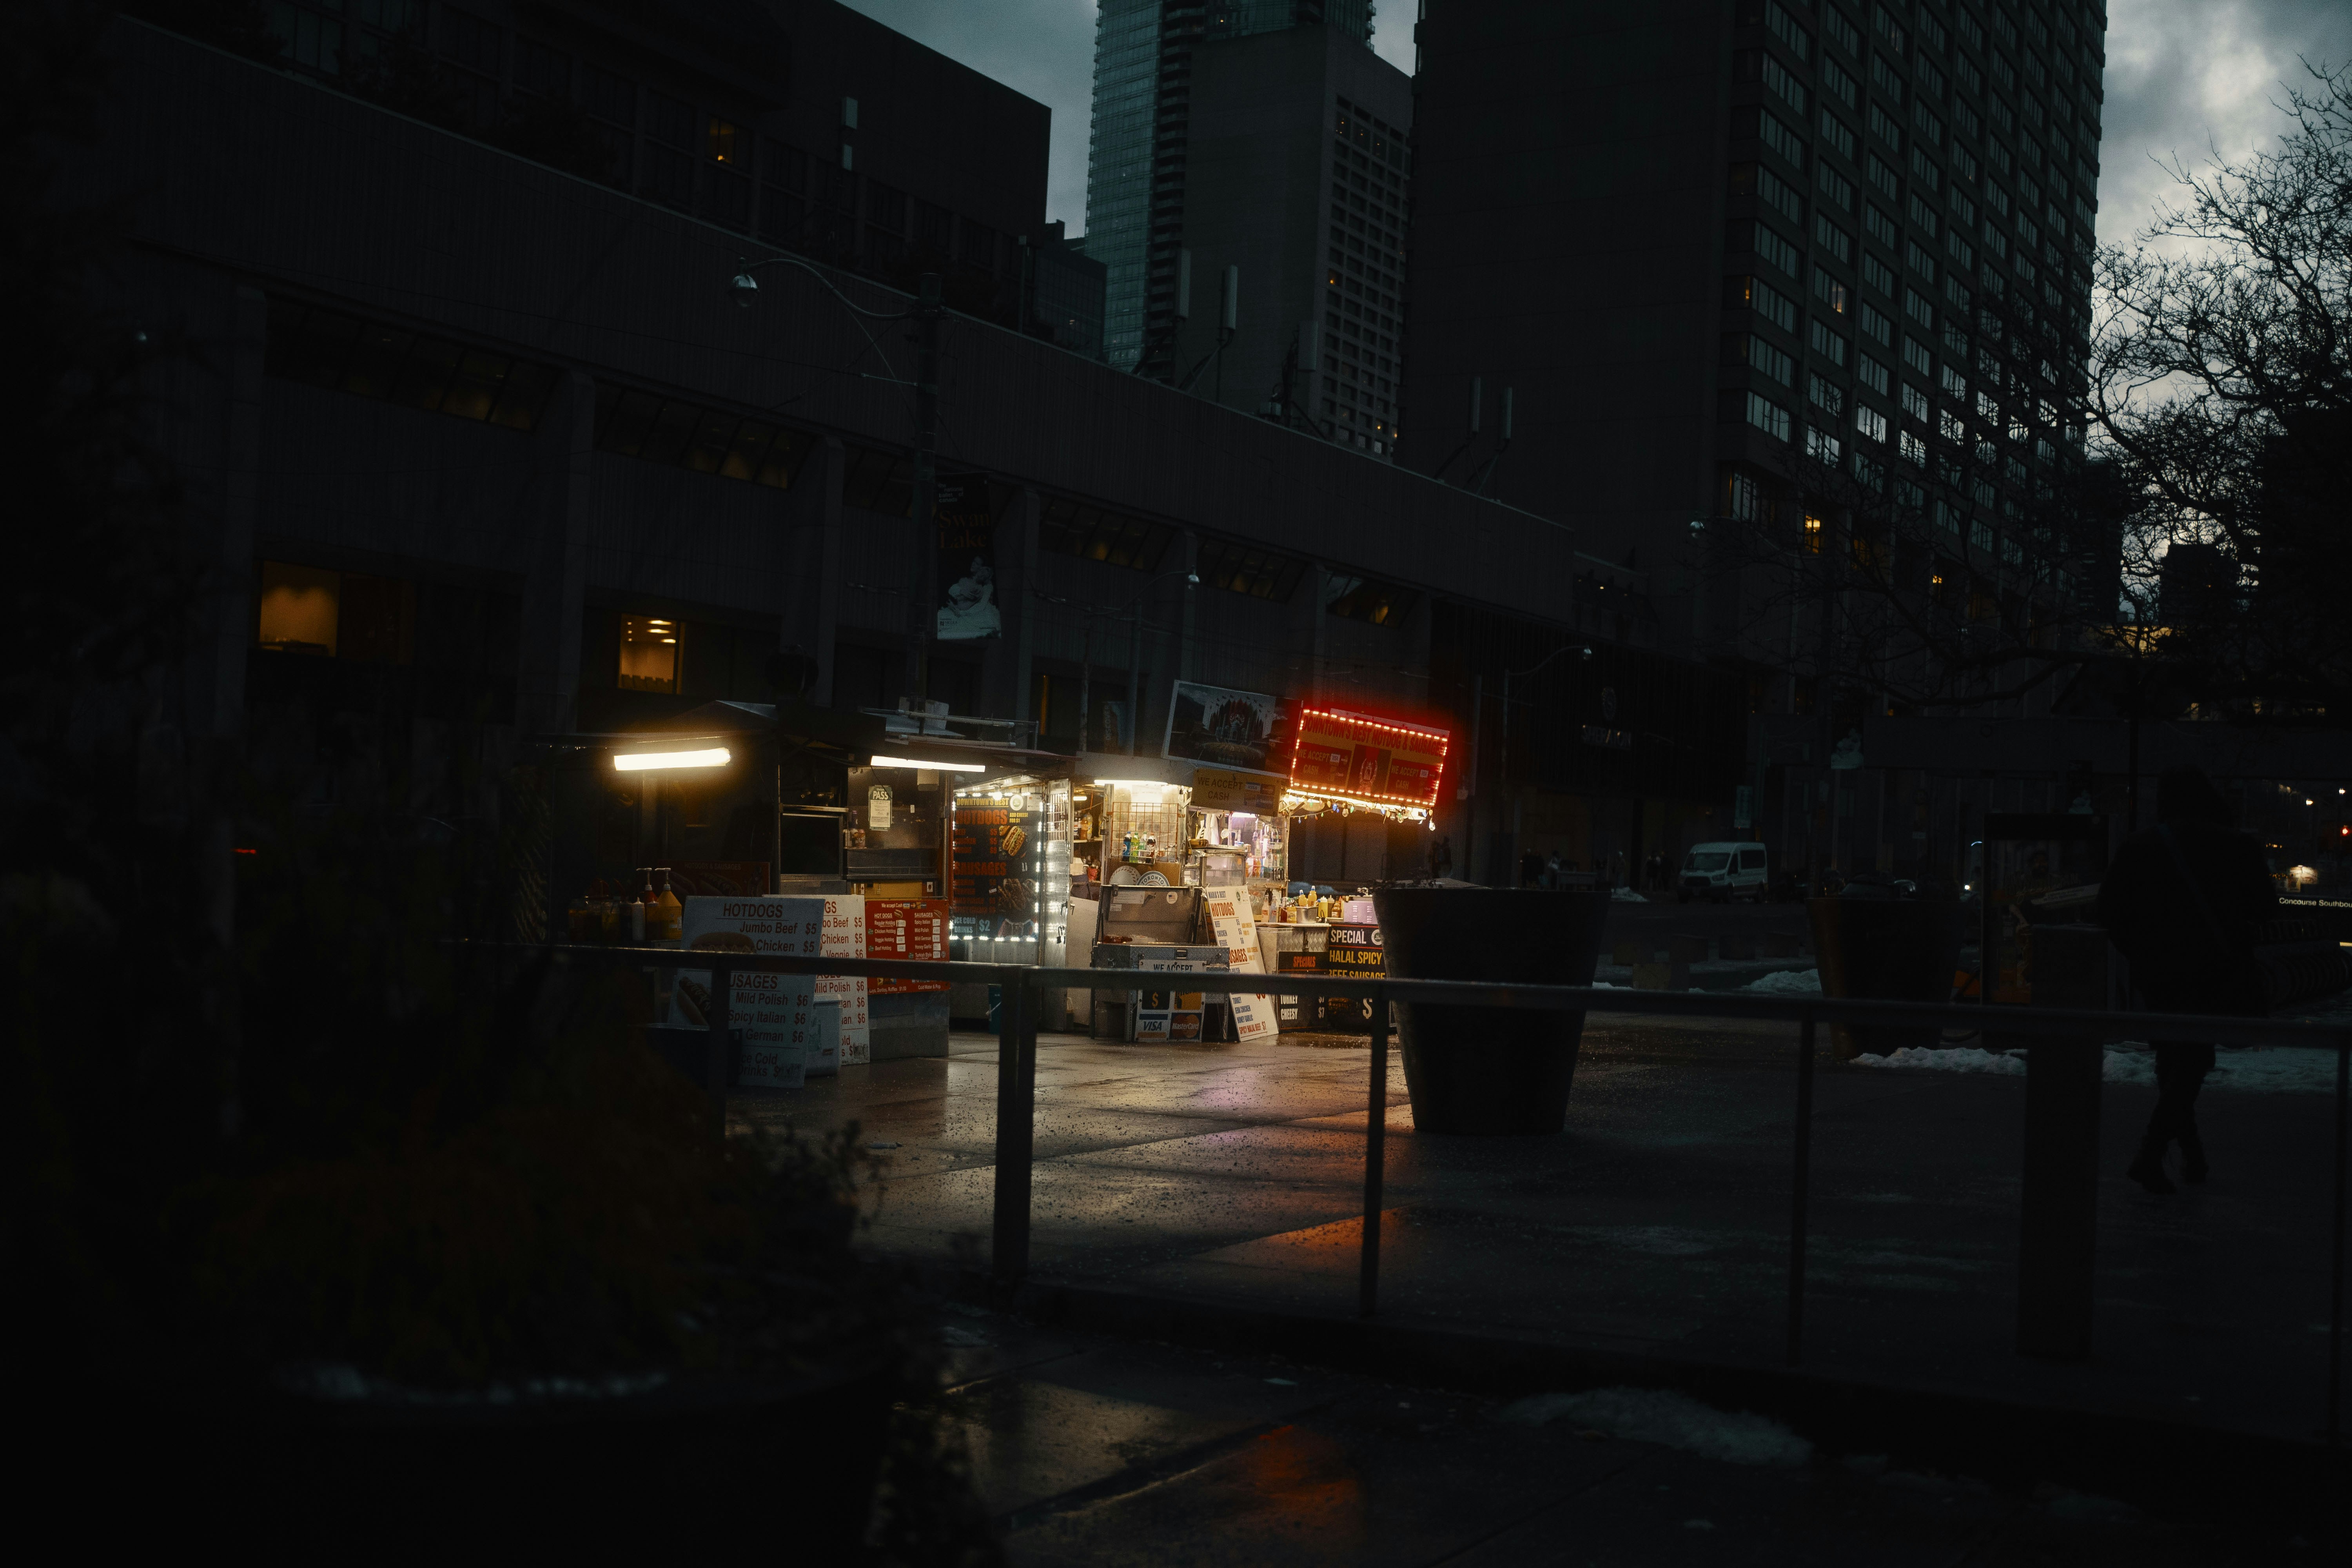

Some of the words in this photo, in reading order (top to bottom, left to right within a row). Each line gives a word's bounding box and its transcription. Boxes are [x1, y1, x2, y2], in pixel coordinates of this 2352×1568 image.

[939, 510, 991, 528] Swan
[940, 529, 987, 548] Lake
[1302, 715, 1352, 739] DOWNTOWN'S
[1352, 725, 1371, 742] BEST
[1372, 729, 1401, 749] HOTDOG
[1403, 737, 1407, 750] &
[1298, 750, 1307, 759] WE
[1308, 751, 1330, 762] ACCEPT
[1303, 764, 1319, 775] CASH
[1391, 765, 1399, 774] WE
[1400, 766, 1419, 777] ACCEPT
[1198, 777, 1210, 786] WE
[1211, 779, 1243, 790] ACCEPT
[1396, 779, 1410, 789] CASH
[873, 791, 889, 800] PASS
[956, 798, 993, 806] DOWNTOWN'S
[995, 798, 1009, 806] BEST
[1208, 791, 1229, 800] CASH
[955, 809, 1007, 825] HOTDOGS
[954, 862, 1006, 876] SAUSAGES
[1272, 868, 1285, 880] 1100
[1141, 875, 1164, 886] TORONTO
[2279, 897, 2317, 906] Concourse
[723, 903, 783, 918] HOTDOGS
[1210, 902, 1235, 917] HOTDOGS
[740, 922, 772, 933] Jumbo
[775, 922, 798, 934] Beef
[805, 923, 817, 935] $5
[833, 917, 849, 928] Beef
[854, 916, 862, 929] $5
[979, 919, 990, 932] $2
[821, 933, 849, 944] Chicken
[855, 932, 863, 945] $5
[1331, 929, 1367, 944] SPECIAL
[756, 939, 795, 952] Chicken
[803, 941, 815, 953] $5
[855, 948, 864, 959] $6
[1329, 950, 1356, 964] HALAL
[1357, 951, 1382, 965] SPICY
[1293, 956, 1316, 967] SPECIALS
[829, 981, 851, 993] Polish
[856, 980, 864, 993] $6
[735, 992, 756, 1004] Mild
[758, 993, 788, 1006] Polish
[797, 995, 808, 1007] $6
[857, 996, 865, 1009] $6
[1280, 995, 1298, 1004] TURKEY
[728, 1010, 754, 1024] Spicy
[757, 1011, 786, 1024] Italian
[794, 1012, 806, 1025] $6
[857, 1013, 866, 1025] $6
[1280, 1008, 1298, 1020] CHEESY
[1318, 1007, 1325, 1019] $7
[1143, 1021, 1163, 1031] VISA
[1239, 1026, 1247, 1034] SPICY
[1261, 1021, 1267, 1031] $7
[746, 1029, 784, 1042] German
[792, 1030, 804, 1044] $6
[755, 1052, 778, 1065] Cold
